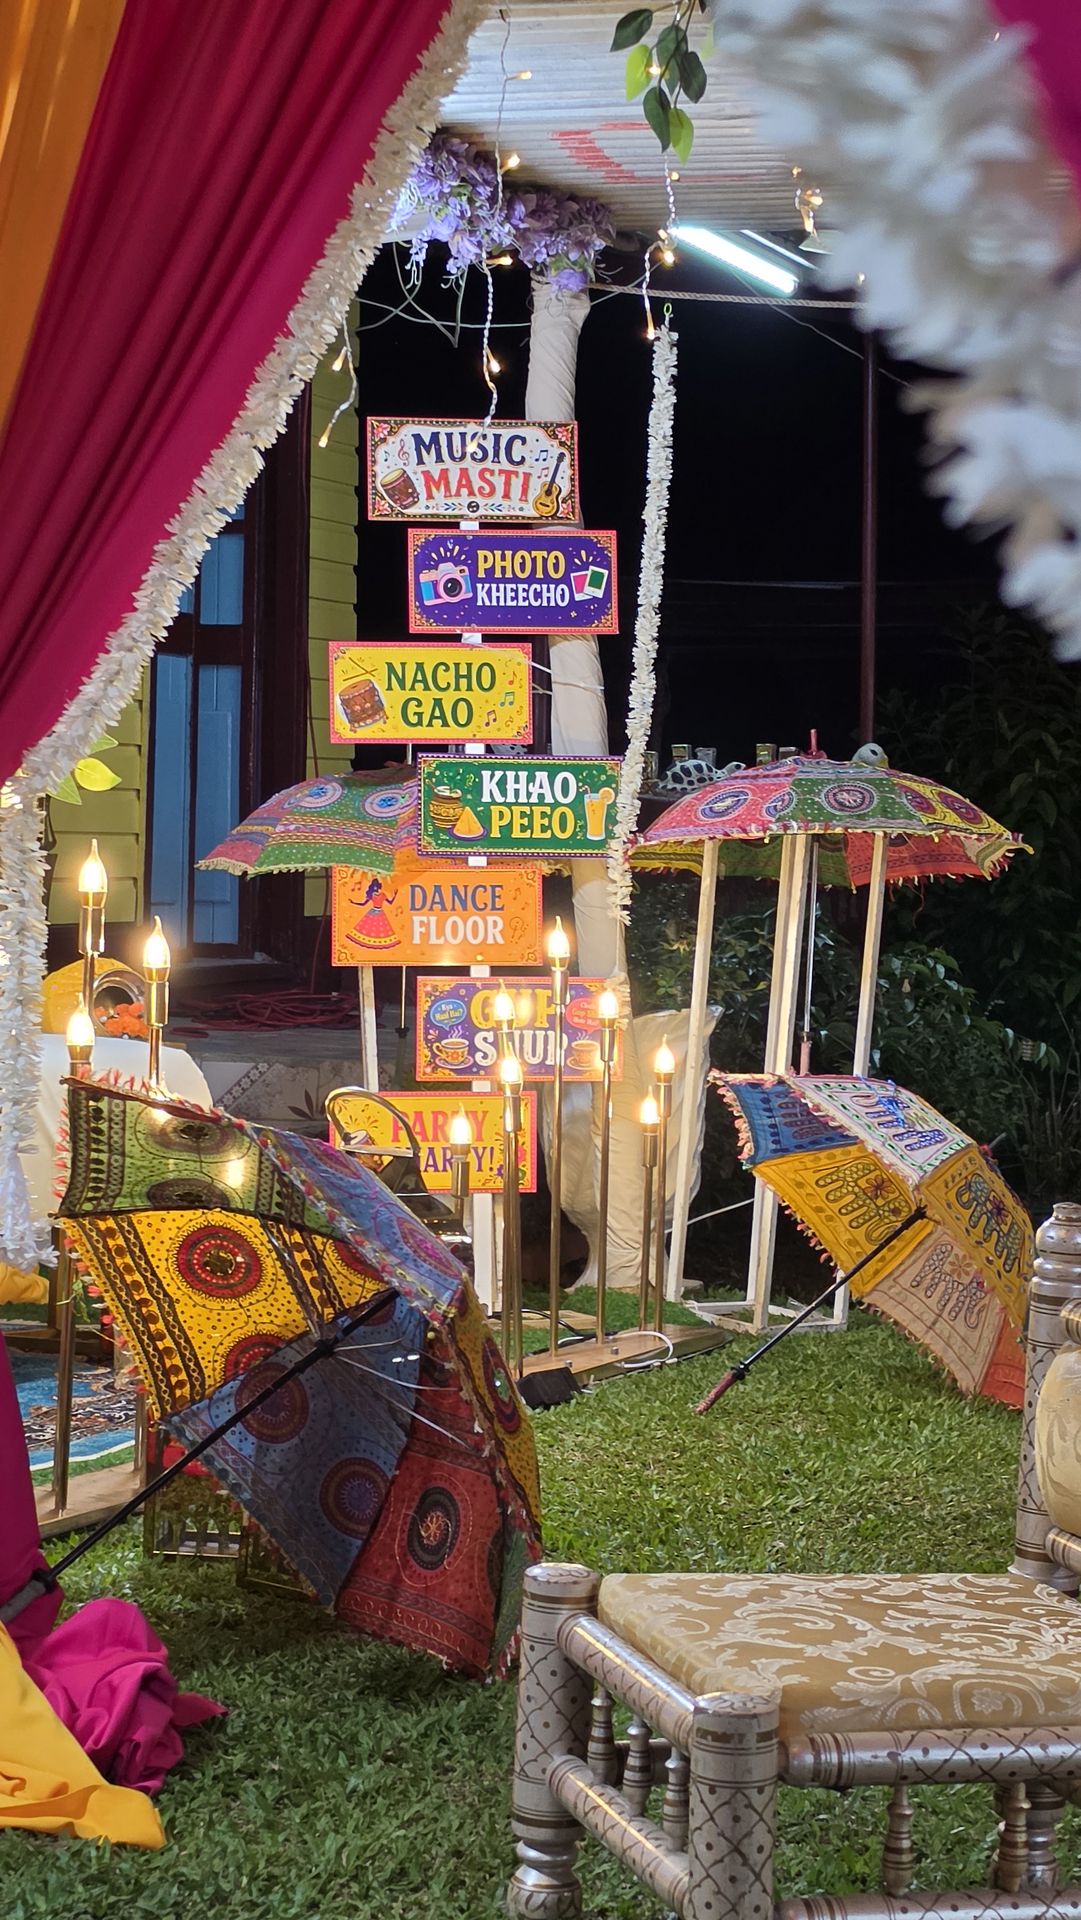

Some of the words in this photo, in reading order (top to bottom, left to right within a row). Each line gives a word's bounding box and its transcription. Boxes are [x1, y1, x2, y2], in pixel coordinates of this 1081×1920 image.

[411, 432, 526, 466] MUSIC
[421, 468, 532, 502] MASTI
[476, 550, 566, 578] PHOTO
[476, 583, 570, 607] KHEECHO
[385, 661, 496, 692] NACHO
[400, 697, 473, 728] GAO
[481, 770, 578, 803] KHAO
[489, 806, 575, 839] PEEO
[408, 885, 505, 911] DANCE
[410, 916, 505, 945] FLOOR
[391, 1111, 488, 1142] PARY
